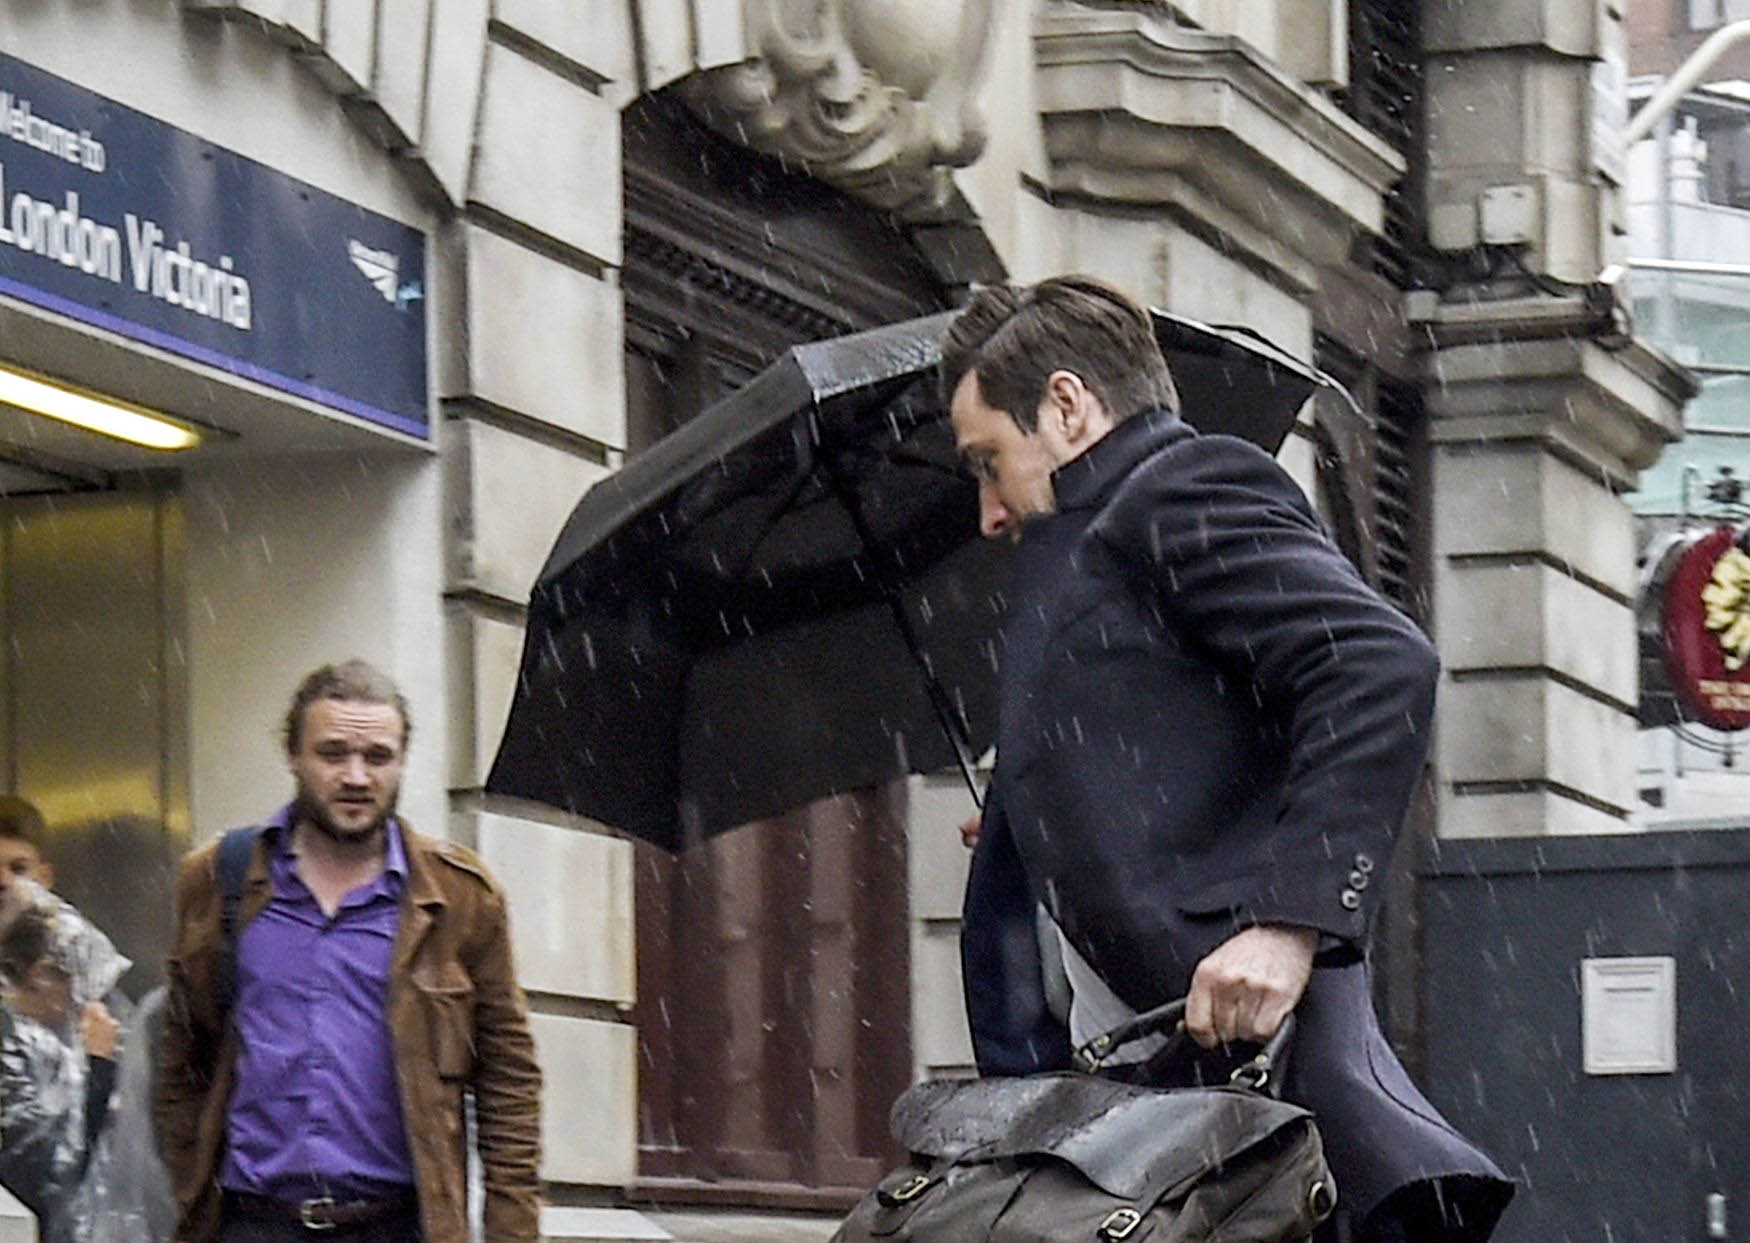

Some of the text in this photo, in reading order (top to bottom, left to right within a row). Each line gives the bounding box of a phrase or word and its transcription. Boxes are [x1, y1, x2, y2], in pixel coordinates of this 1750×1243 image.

[80, 130, 105, 173] to
[0, 162, 251, 330] London Victoria
